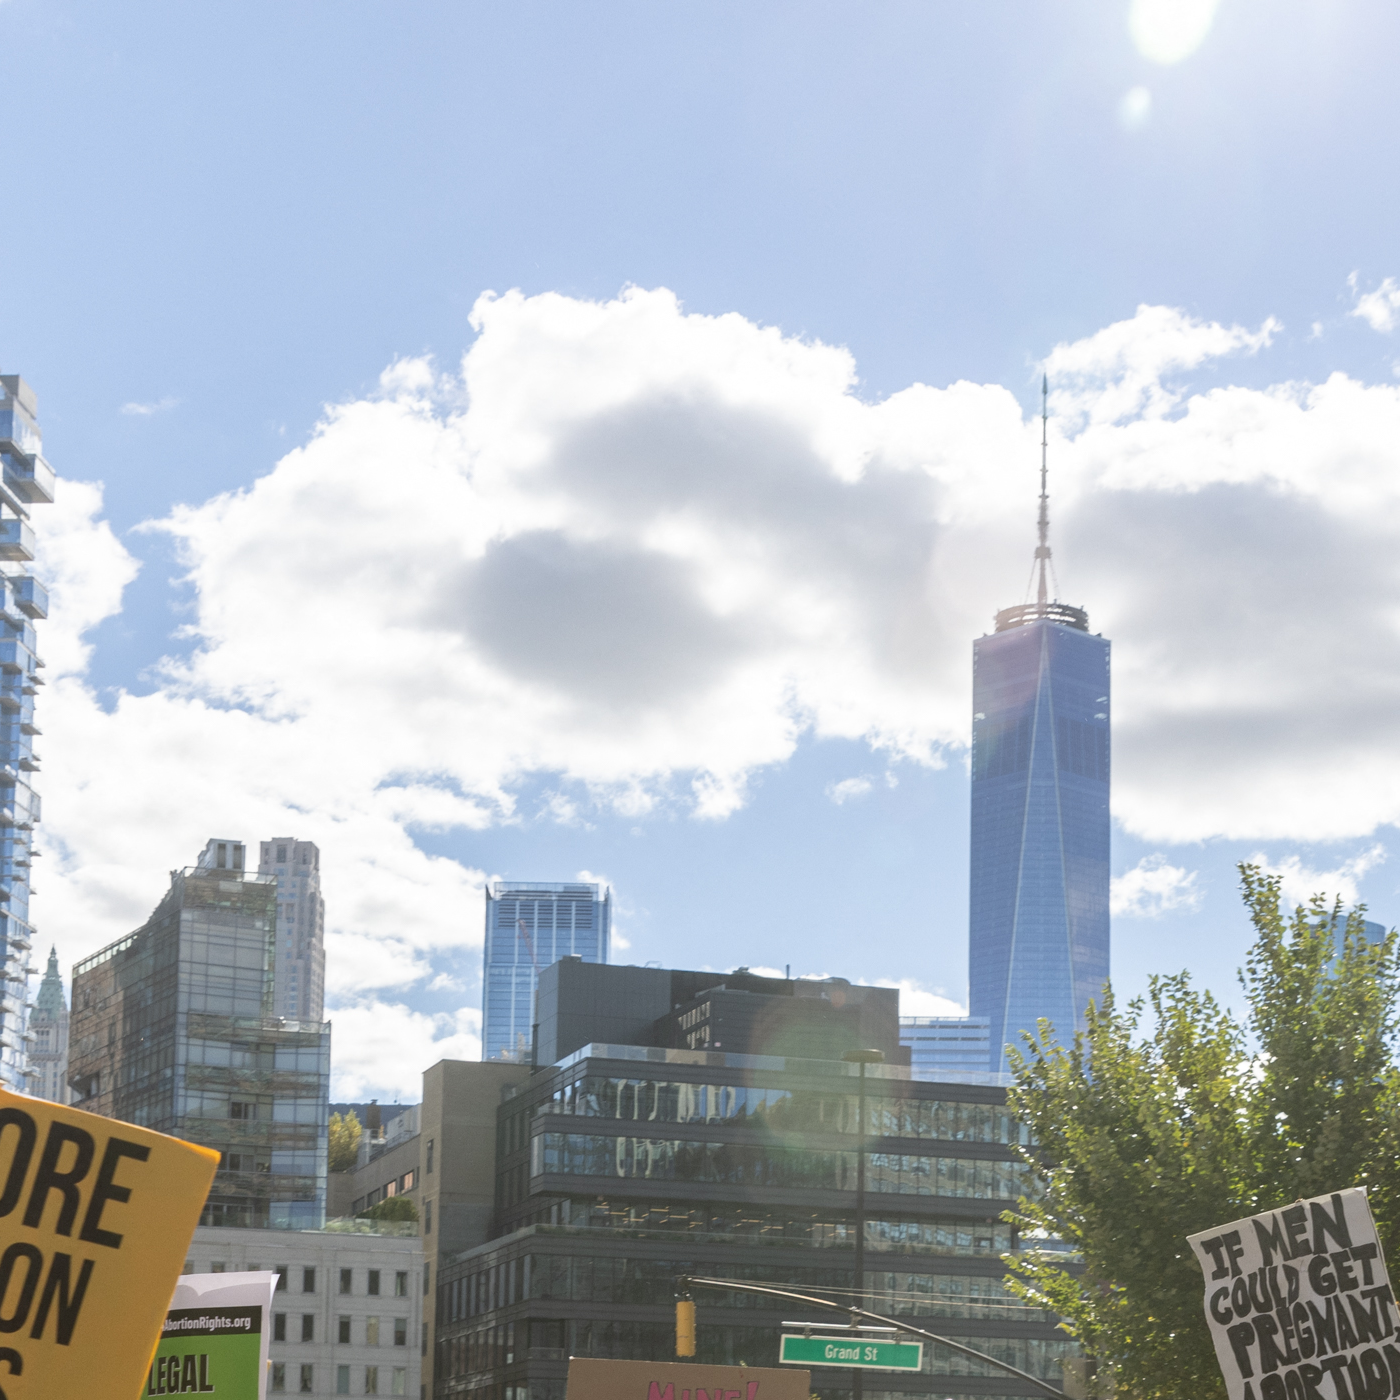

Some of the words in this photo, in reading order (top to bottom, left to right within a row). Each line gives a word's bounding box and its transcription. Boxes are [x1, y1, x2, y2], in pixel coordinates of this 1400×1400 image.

[1200, 1229, 1243, 1281] IF
[1251, 1193, 1353, 1262] MEN
[1209, 1264, 1300, 1327] COULD
[1307, 1241, 1378, 1297] GET
[163, 1315, 251, 1332] AbortionRights.org
[147, 1353, 215, 1397] LEGAL
[824, 1344, 863, 1361] Grand
[865, 1346, 879, 1362] St
